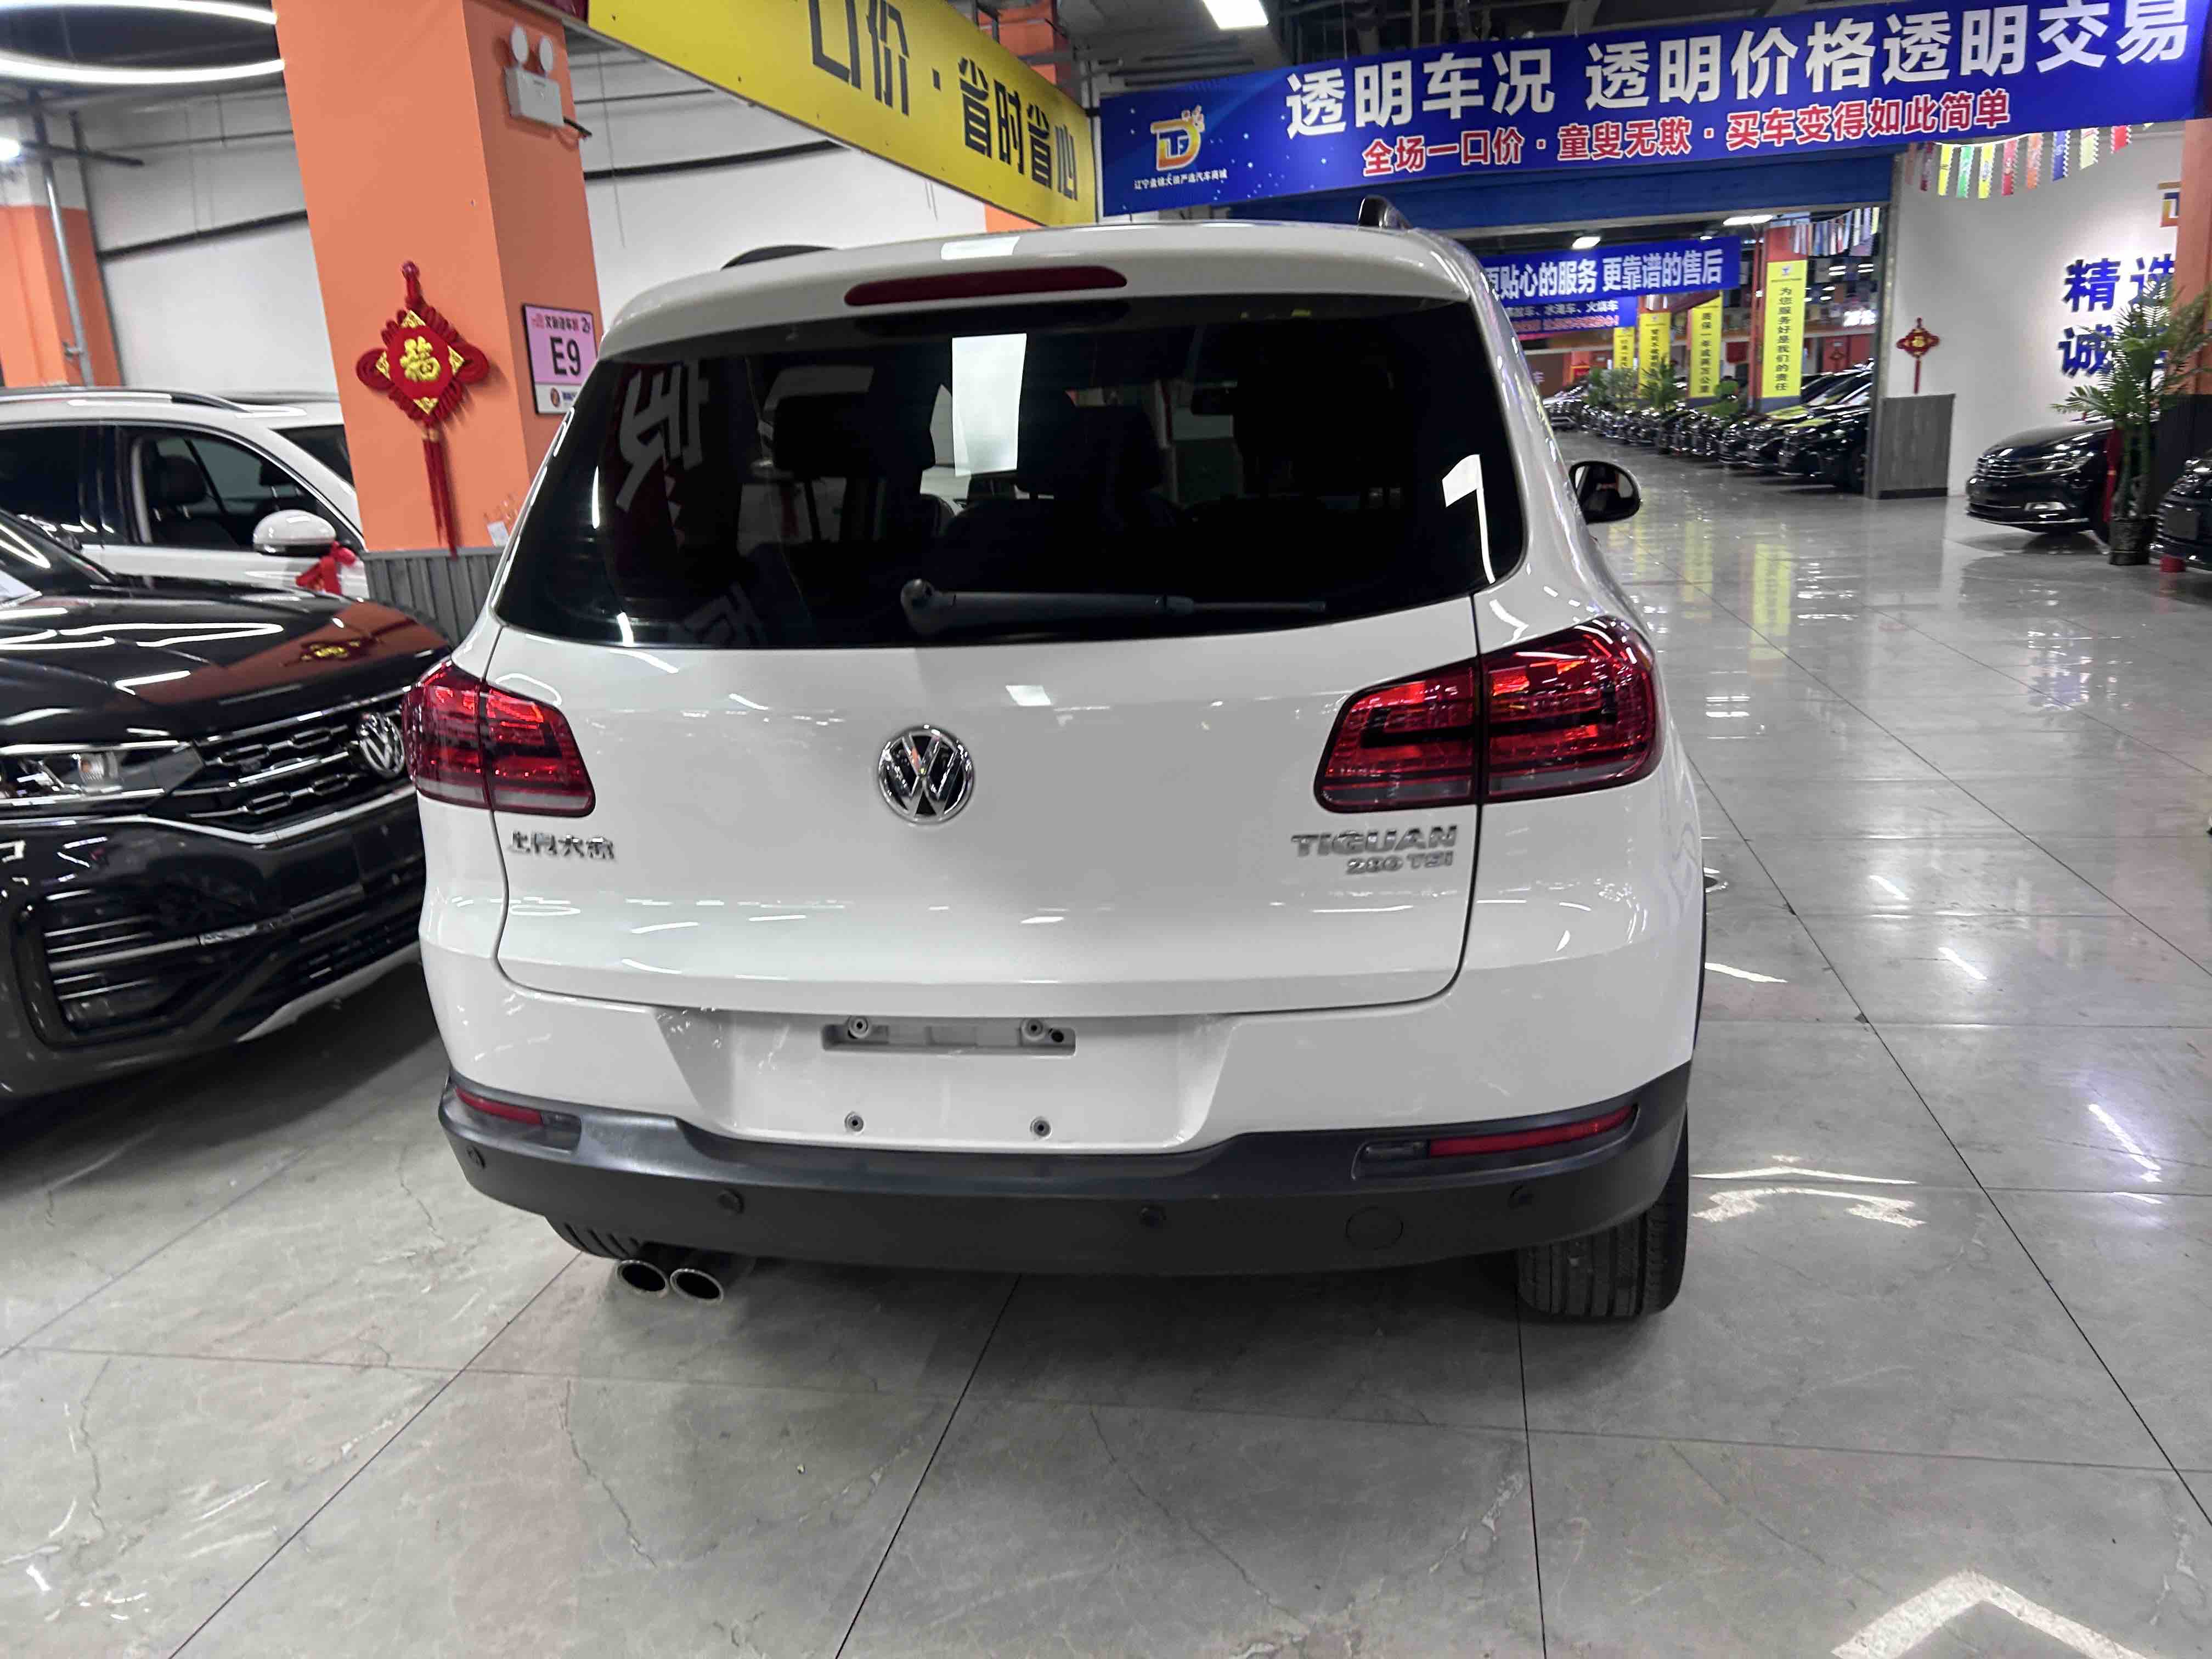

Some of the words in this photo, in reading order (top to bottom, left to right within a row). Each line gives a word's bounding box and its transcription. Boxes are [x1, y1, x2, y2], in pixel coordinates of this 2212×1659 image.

[1285, 48, 1556, 140] 透明车况
[1585, 0, 2189, 113] 透明价格透明交易
[1602, 249, 1724, 292] 更靠谱的售后
[550, 336, 581, 376] E9
[1291, 825, 1457, 857] TIGUAN
